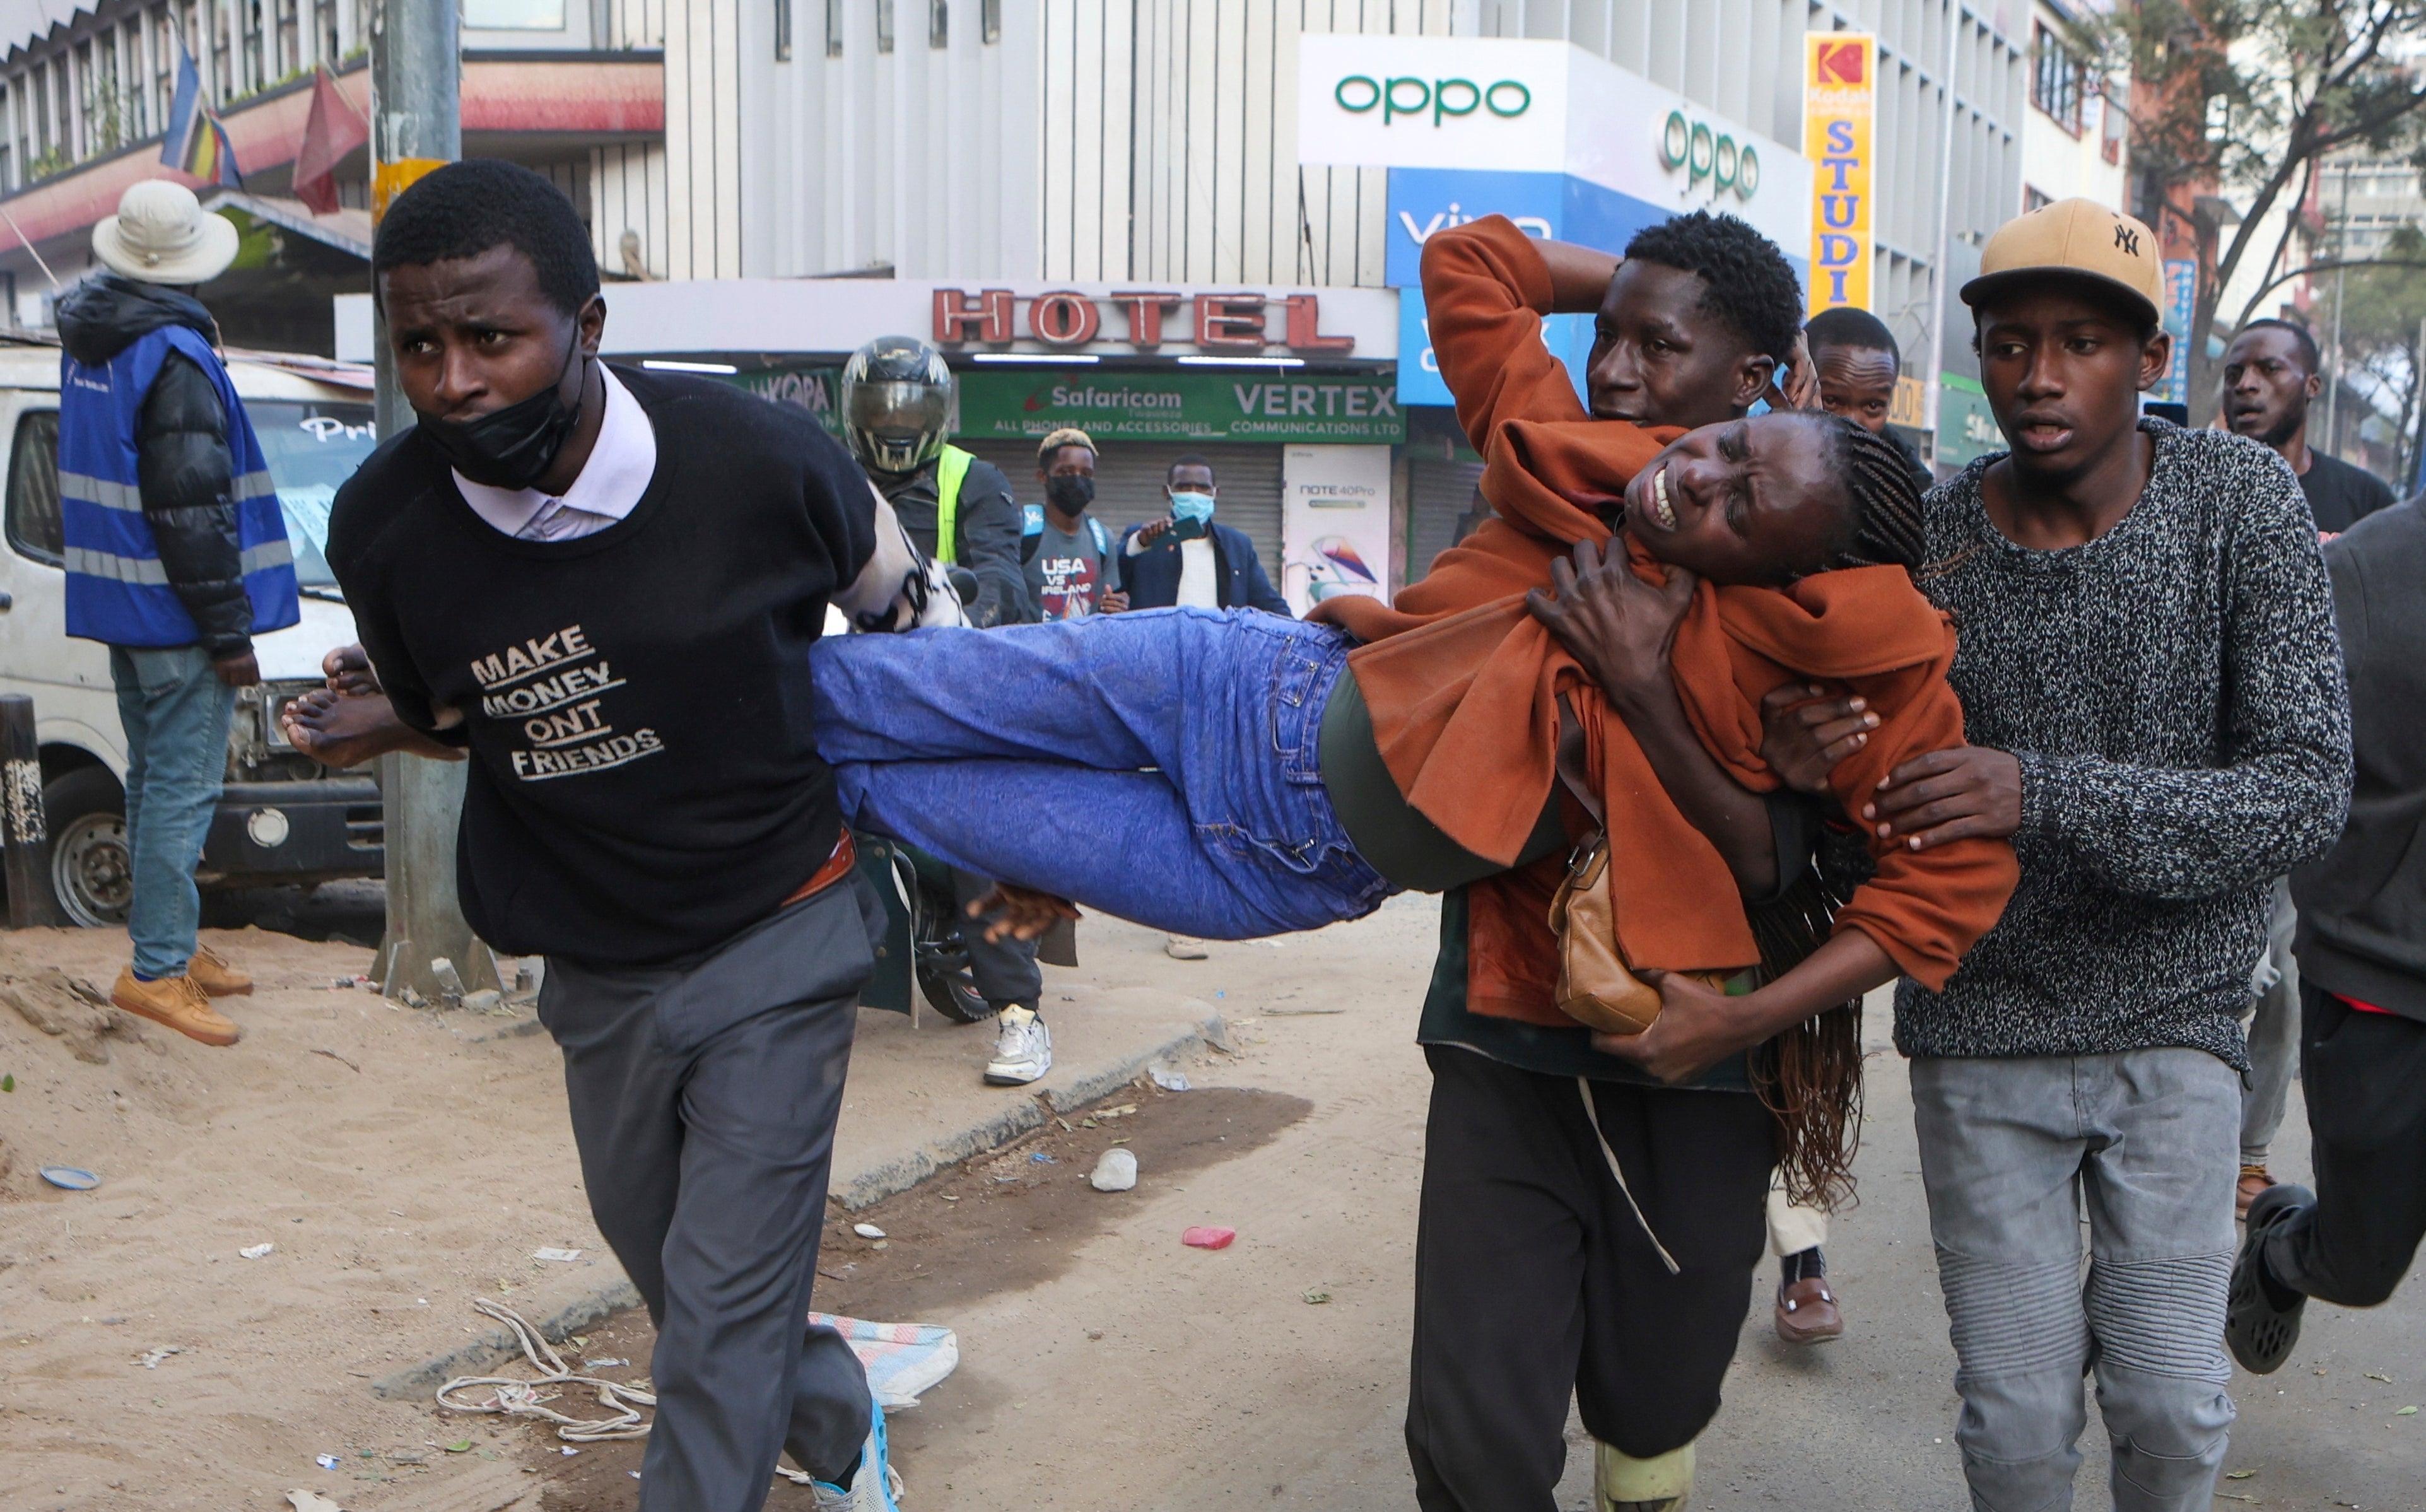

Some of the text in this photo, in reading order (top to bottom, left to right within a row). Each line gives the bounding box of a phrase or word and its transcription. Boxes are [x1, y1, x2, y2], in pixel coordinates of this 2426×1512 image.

[1335, 74, 1531, 127] oppo
[1663, 110, 1759, 201] oppo
[1819, 120, 1858, 303] STUDI
[933, 288, 1355, 348] HOTEL
[1052, 385, 1182, 408] Safaricom
[1234, 383, 1397, 416] VERTEX
[299, 417, 376, 443] Pri
[994, 419, 1212, 434] ALL PHONES AND ACCESSORIES
[1230, 420, 1400, 435] COMMUNICATIONS LTD
[1041, 557, 1087, 575] USA
[1046, 575, 1066, 585] VS
[1041, 582, 1092, 595] IRELAND
[471, 623, 590, 685] MAKE
[483, 660, 610, 717] MONEY
[524, 698, 602, 742] ONT
[512, 727, 662, 775] FRIENDS
